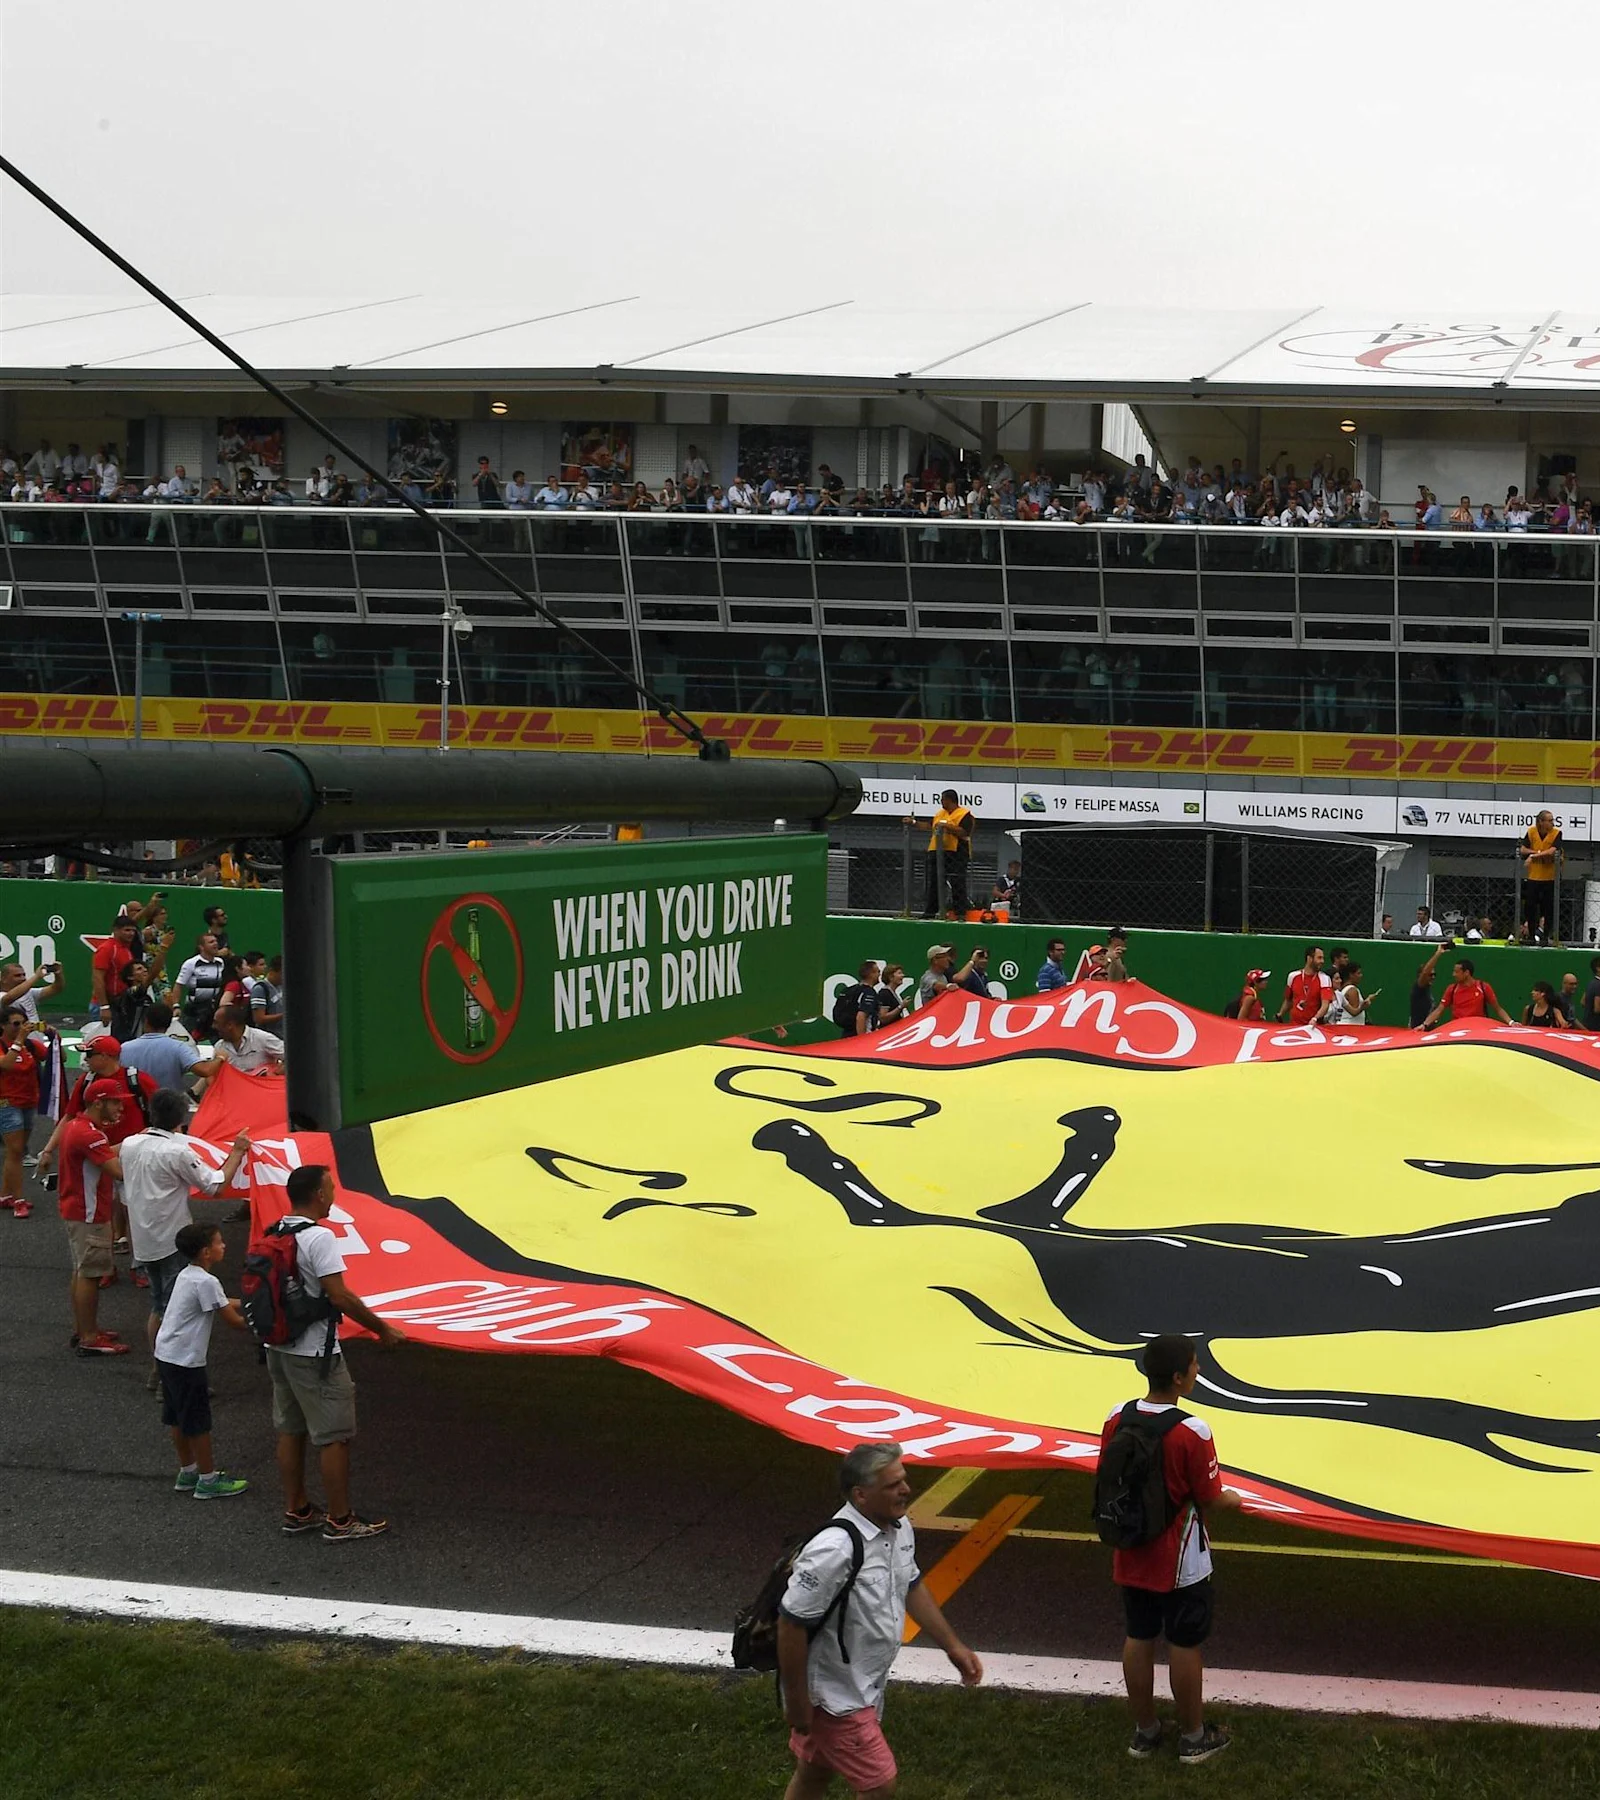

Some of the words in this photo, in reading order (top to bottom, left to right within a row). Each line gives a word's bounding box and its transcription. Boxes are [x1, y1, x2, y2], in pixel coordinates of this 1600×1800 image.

[0, 699, 133, 729] DHL
[200, 705, 341, 736] DHL
[415, 710, 563, 743] DHL
[868, 723, 1030, 758] DHL
[1104, 731, 1265, 767] DHL
[1344, 739, 1510, 775] DHL
[862, 791, 889, 803] RED
[893, 792, 928, 805] BULL
[933, 793, 983, 806] RING
[1053, 797, 1067, 810] 19
[1075, 798, 1116, 811] FELIPE
[1119, 801, 1160, 813] MASSA
[1238, 804, 1307, 818] WILLIAMS
[1311, 807, 1364, 820] RACING
[1435, 811, 1450, 824] 77
[1457, 812, 1514, 827] VALTTERI
[553, 890, 647, 960] WHEN
[656, 882, 715, 945] YOU
[722, 874, 793, 935] DRIVE
[554, 957, 651, 1033] NEVER
[661, 941, 743, 1011] DRINK
[875, 988, 1198, 1060] Cuore
[345, 1279, 686, 1346] Club
